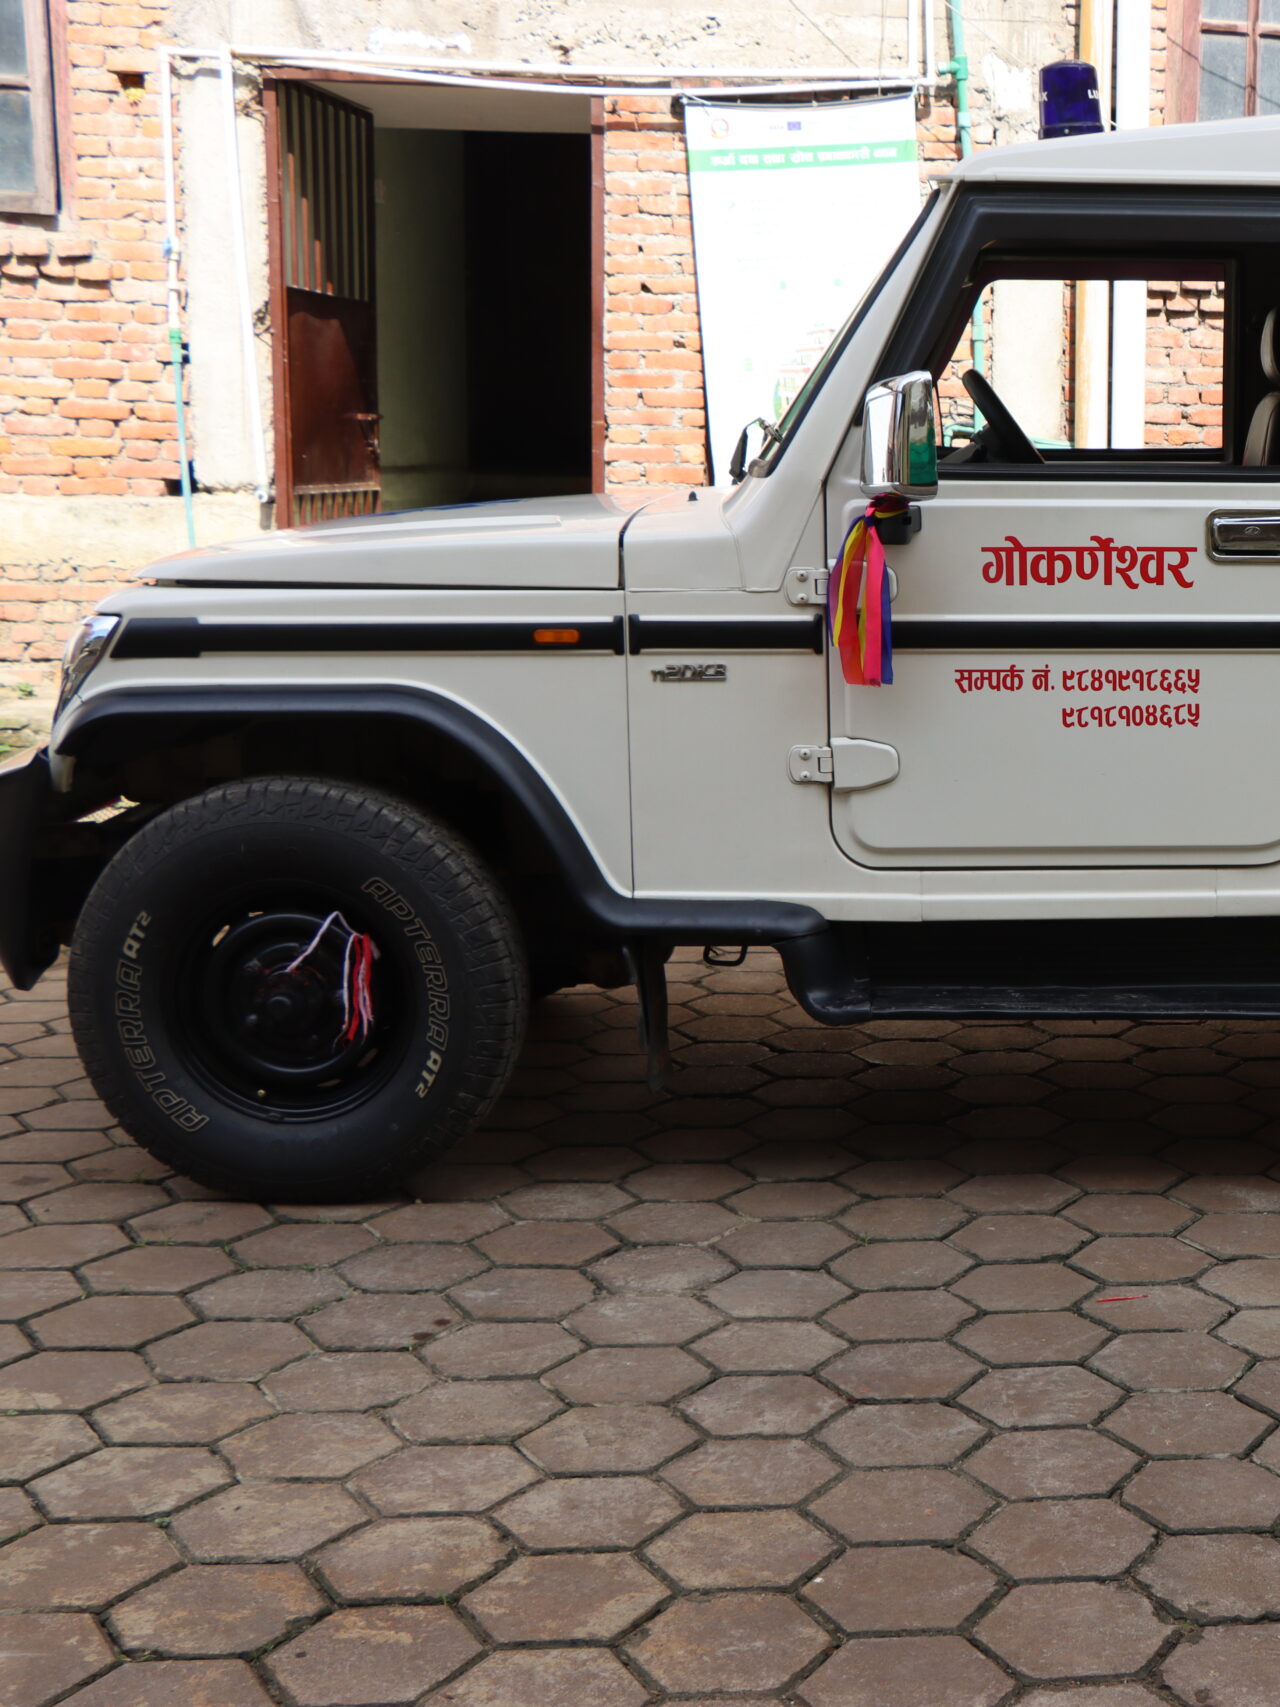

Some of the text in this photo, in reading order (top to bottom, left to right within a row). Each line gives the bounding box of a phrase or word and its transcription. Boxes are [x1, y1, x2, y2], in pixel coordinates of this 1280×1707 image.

[981, 535, 1198, 590] गोकर्णेश्वर
[955, 664, 1200, 694] सम्पर्क नं. ९८४१९१८६६५
[1062, 703, 1200, 728] ९८१८१०४६८५
[361, 877, 451, 1051] APTERRA
[115, 960, 210, 1132] APTERRA
